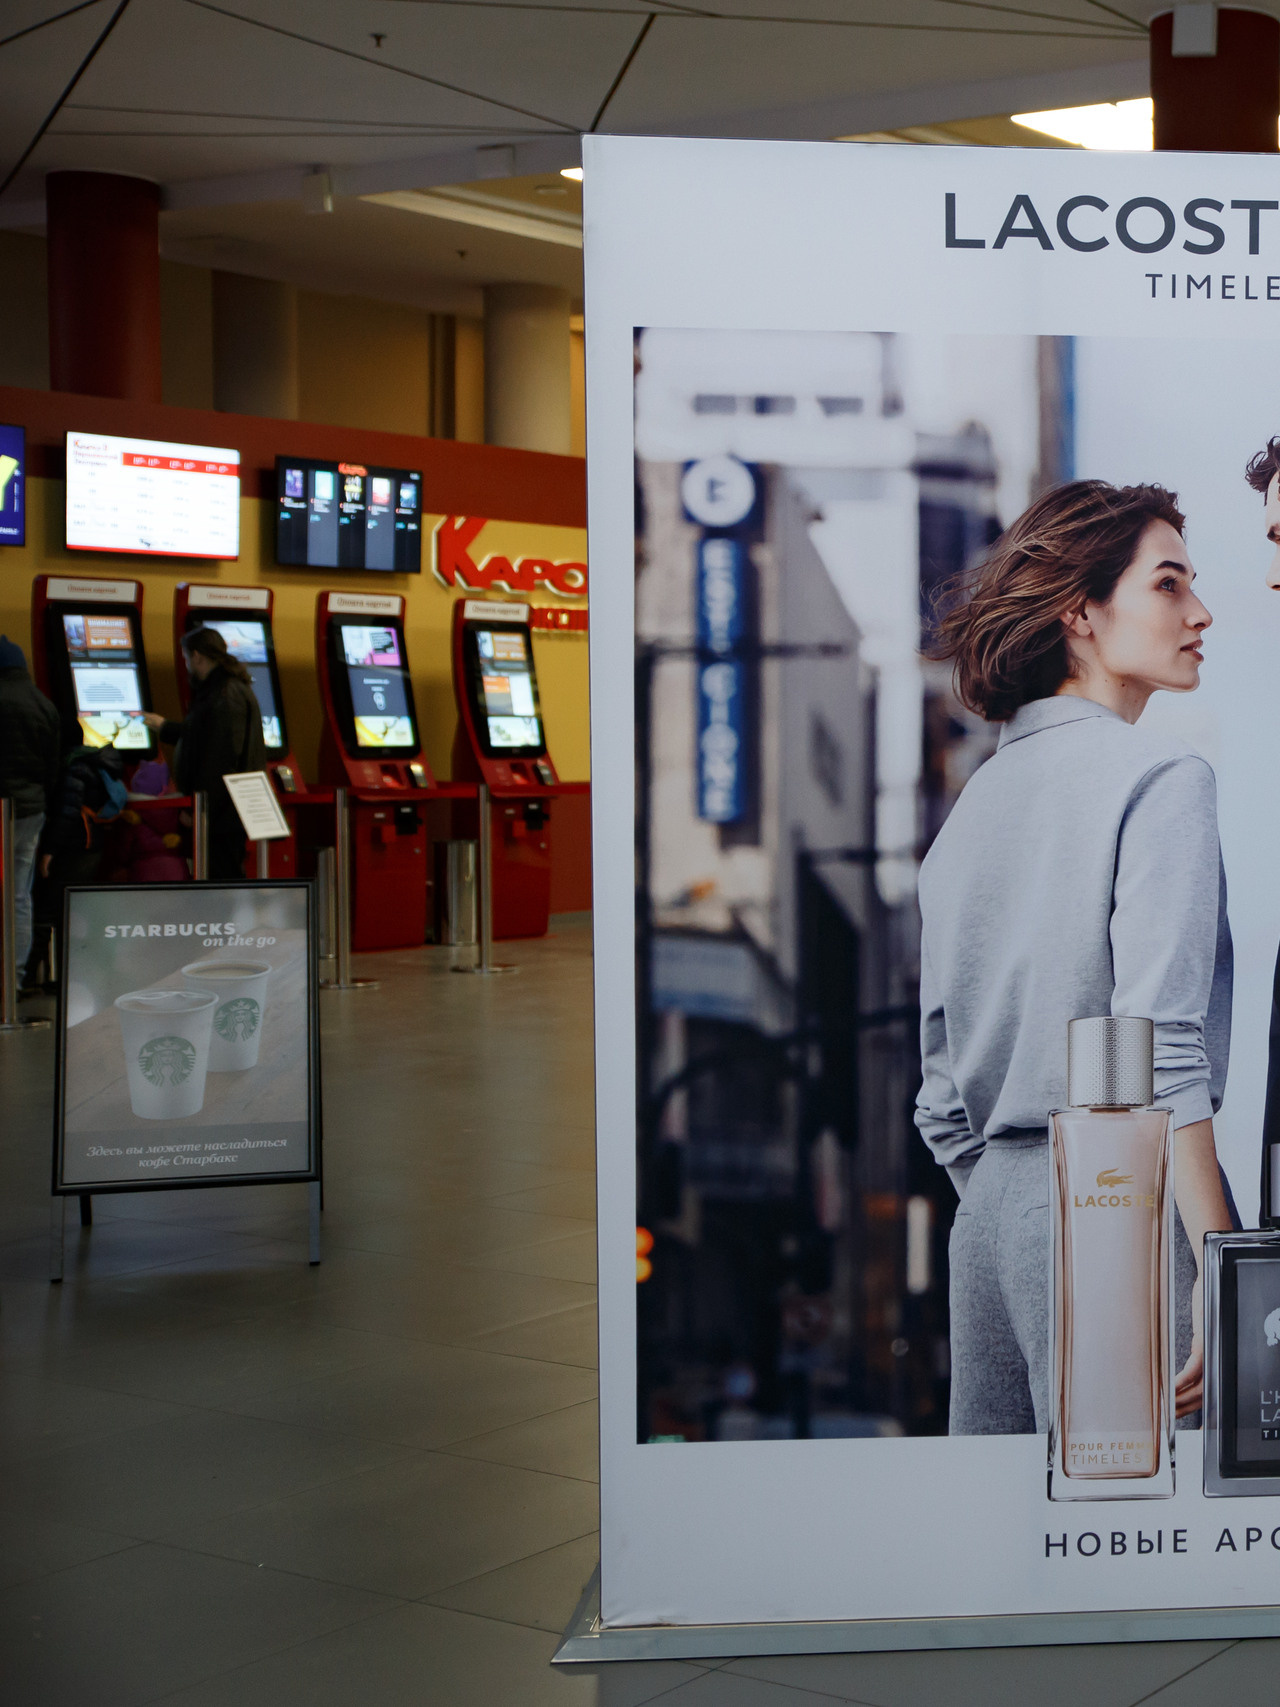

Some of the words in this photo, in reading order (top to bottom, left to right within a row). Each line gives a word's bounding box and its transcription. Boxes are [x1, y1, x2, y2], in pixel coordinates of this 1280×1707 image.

[104, 922, 236, 938] STARBUCKS
[202, 936, 224, 947] on
[227, 934, 253, 946] the
[256, 936, 277, 949] go
[86, 1145, 123, 1157] Здесь
[126, 1146, 143, 1155] вы
[145, 1143, 201, 1154] можете
[204, 1138, 288, 1152] насладиться
[138, 1154, 170, 1169] кофе
[173, 1152, 239, 1167] Старбакс
[1074, 1194, 1155, 1208] LACOSTE
[1070, 1442, 1104, 1452] POUR
[1044, 1528, 1189, 1558] НОВЫЕ
